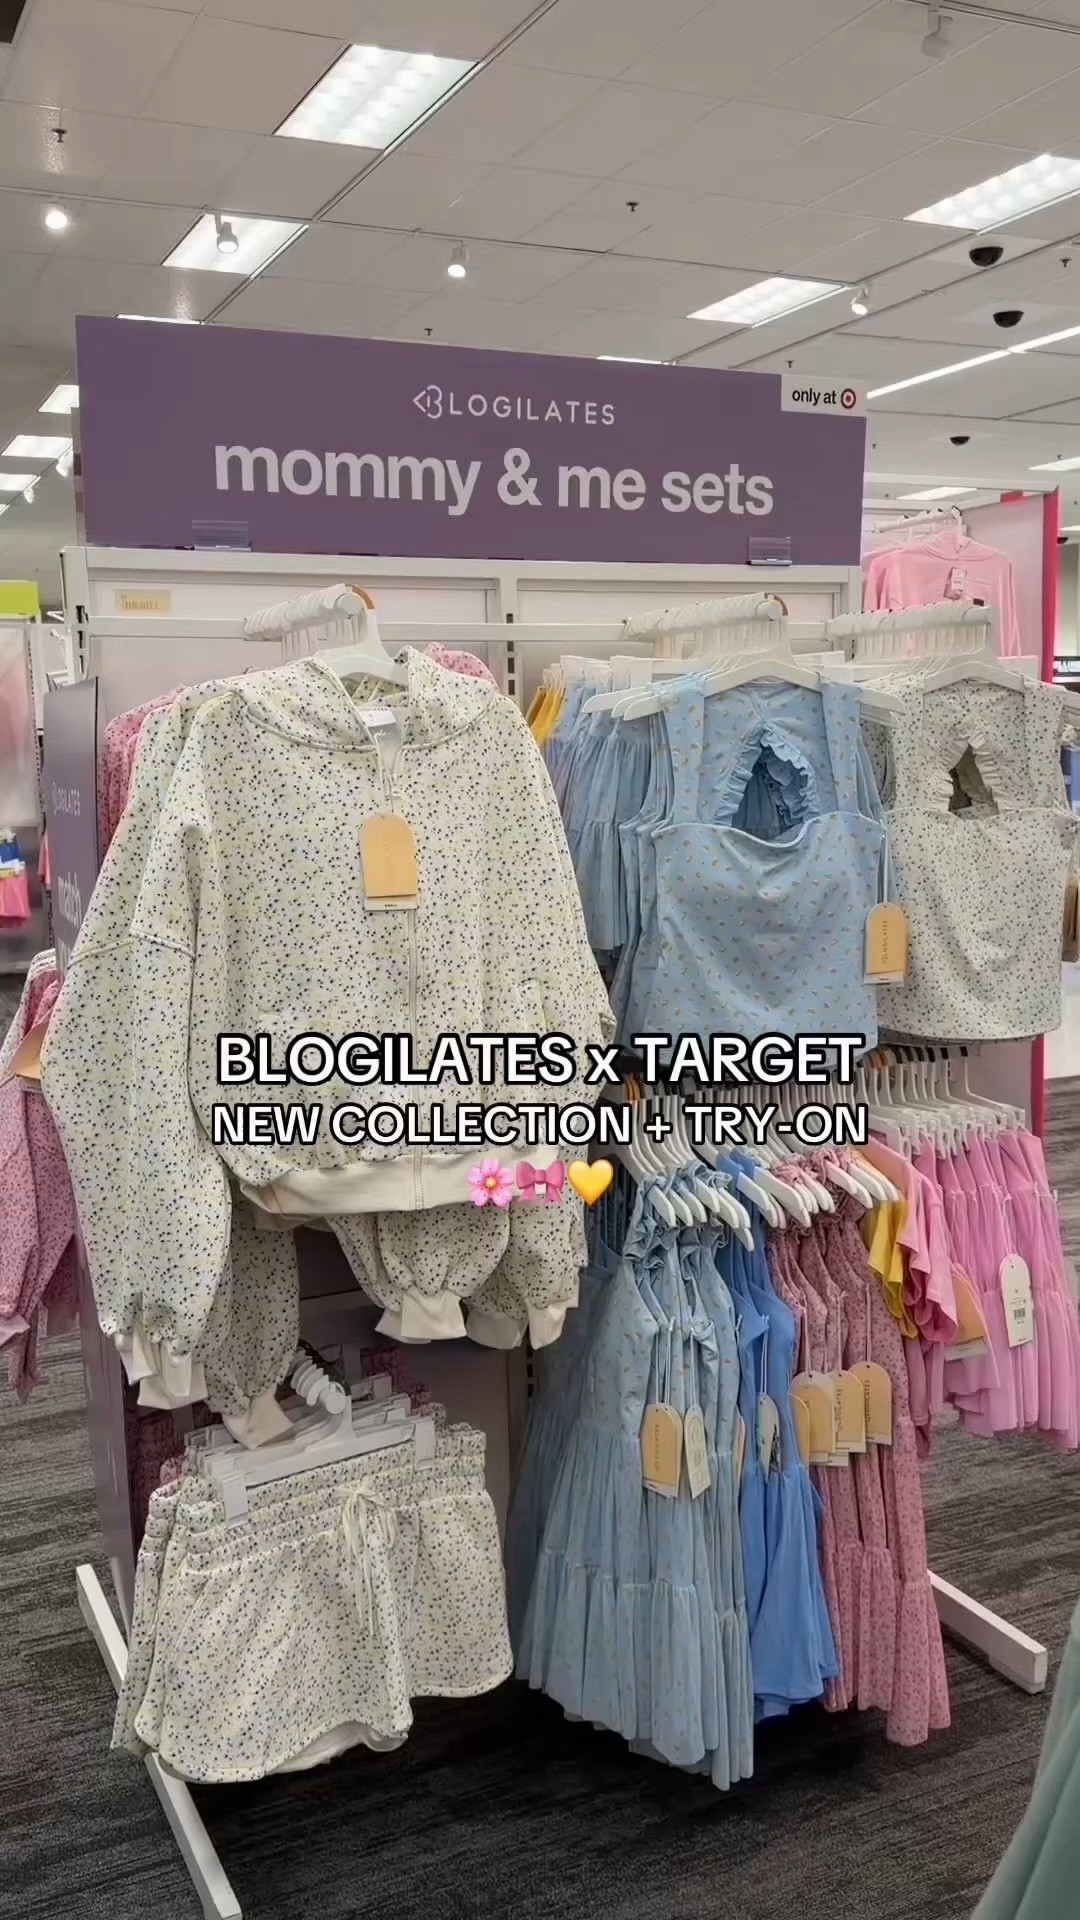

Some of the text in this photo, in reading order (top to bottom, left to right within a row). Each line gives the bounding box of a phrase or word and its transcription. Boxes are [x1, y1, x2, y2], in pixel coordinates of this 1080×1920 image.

[791, 387, 837, 407] only at
[214, 444, 775, 517] mommy & me sets
